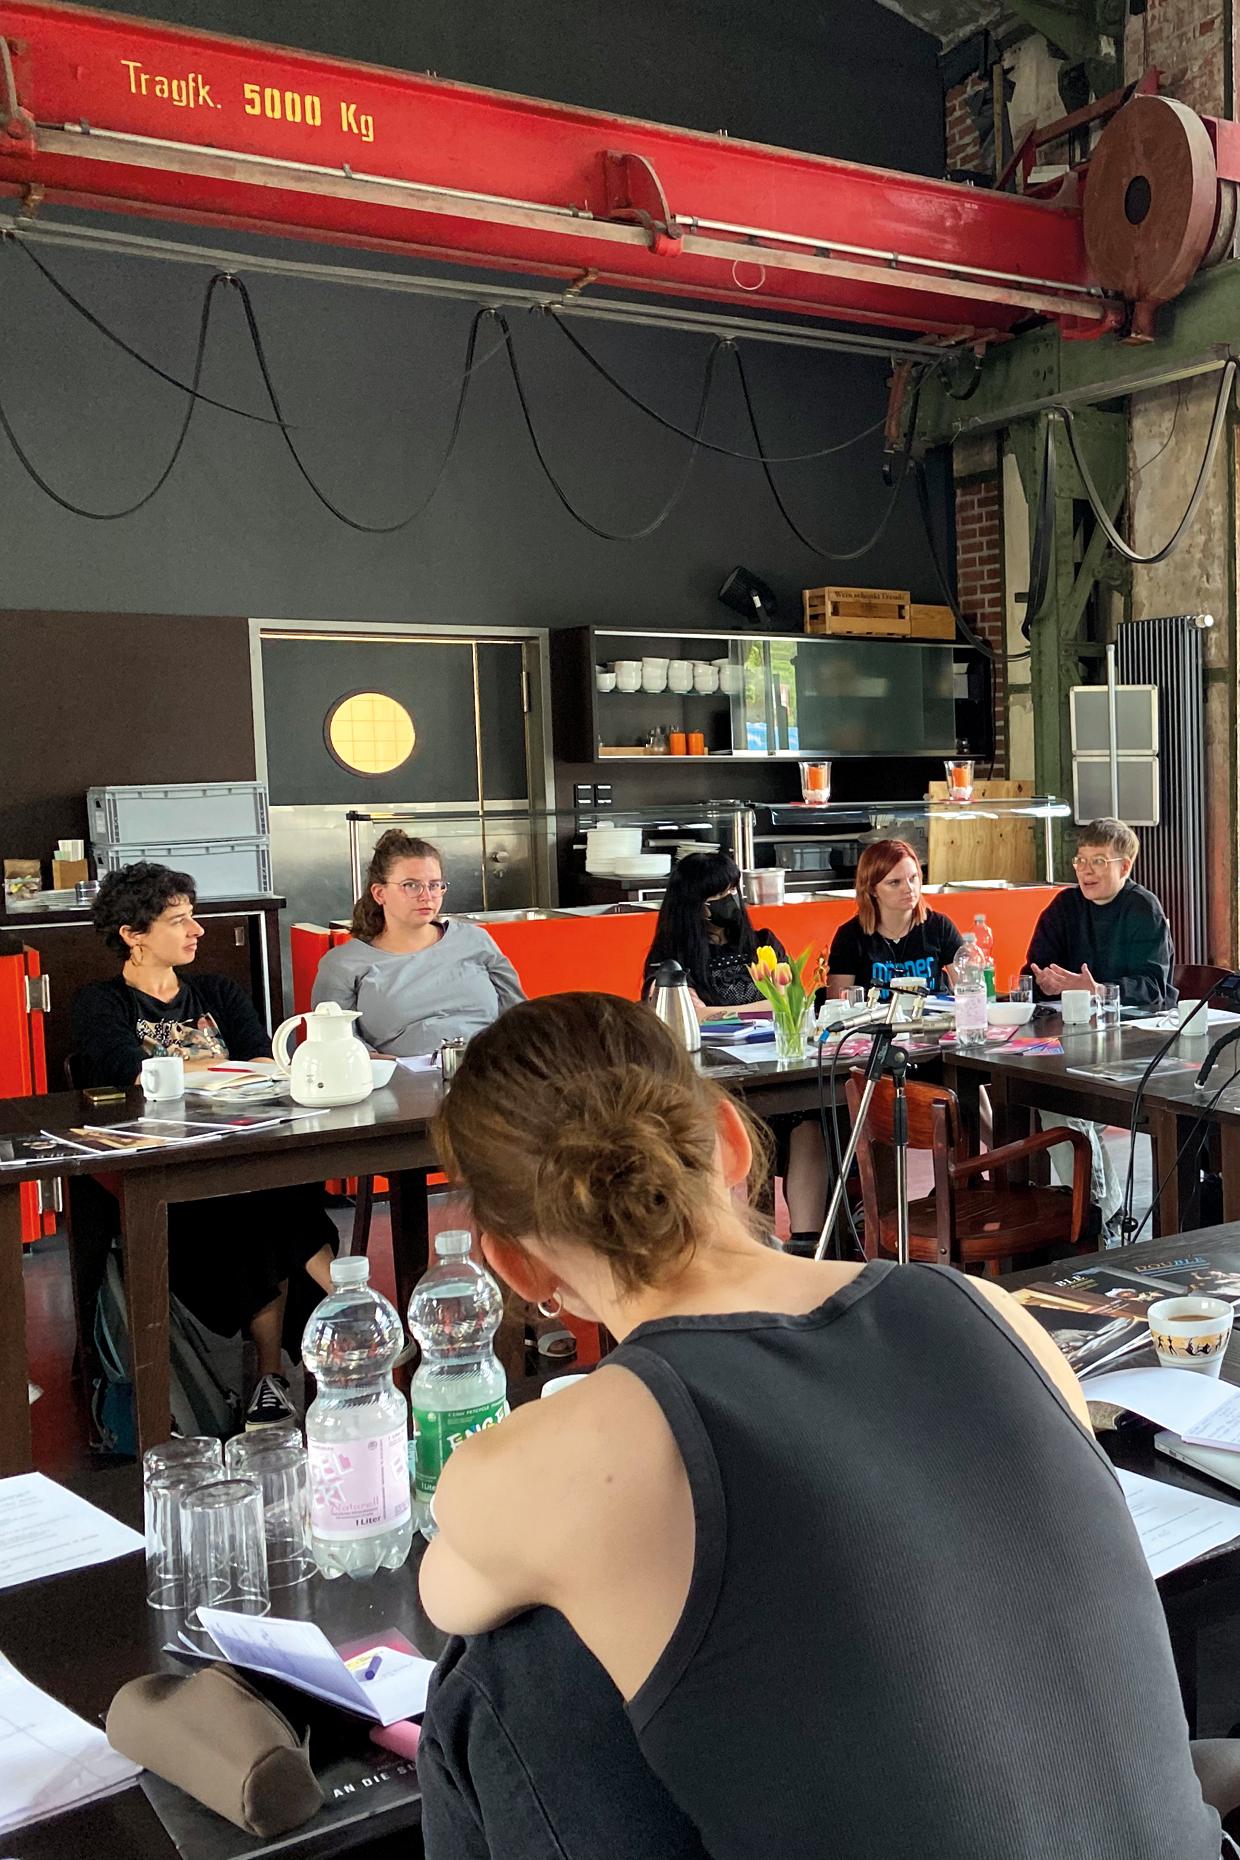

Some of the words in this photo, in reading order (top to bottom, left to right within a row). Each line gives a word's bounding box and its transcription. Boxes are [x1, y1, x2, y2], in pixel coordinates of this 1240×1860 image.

[120, 60, 222, 108] Tragfk.
[243, 83, 322, 127] 5000
[340, 101, 375, 142] Kg
[1054, 1274, 1089, 1287] BLE
[424, 1483, 436, 1491] Lite
[361, 1515, 382, 1526] Liter
[333, 1783, 356, 1798] AN
[361, 1772, 391, 1788] DIE
